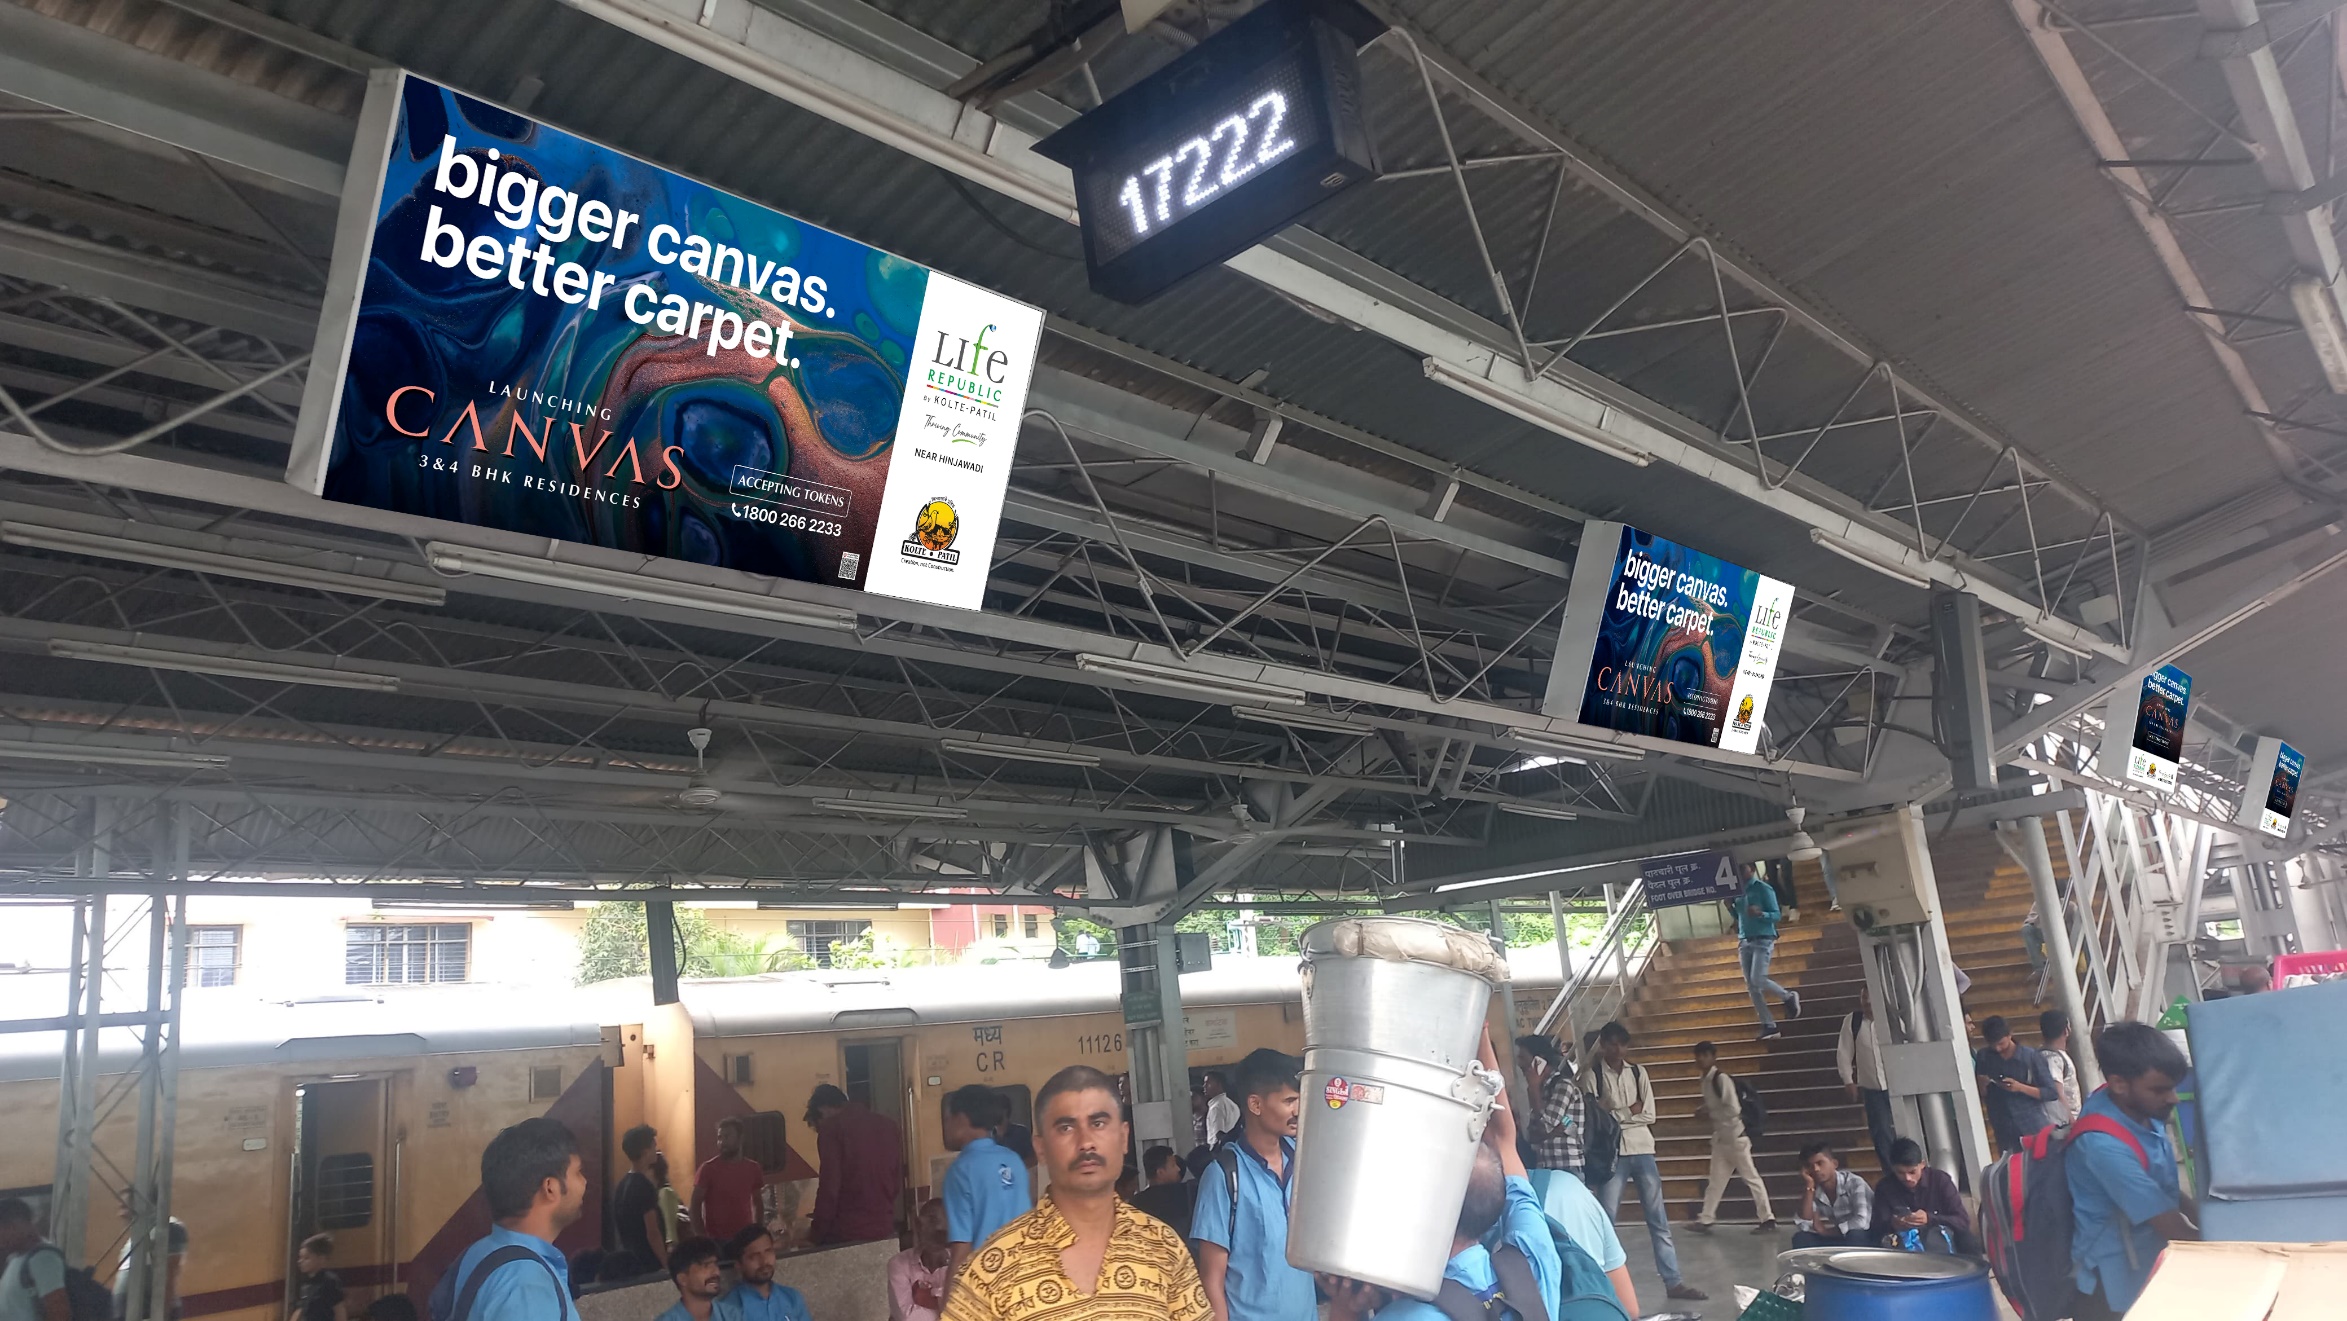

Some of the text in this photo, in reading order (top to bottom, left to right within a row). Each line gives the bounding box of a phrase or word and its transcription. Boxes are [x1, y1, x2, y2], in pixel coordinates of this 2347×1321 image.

[1120, 91, 1294, 234] 17222
[434, 133, 836, 319] bigger canvas.
[420, 204, 801, 369] better carpet.
[488, 380, 612, 422] LAUNCHING
[928, 368, 1002, 402] REPUBLIC
[934, 395, 996, 422] KOLTE-PATIL
[386, 385, 685, 490] CANVAS
[914, 447, 984, 473] NEAR HINJAWADI
[472, 464, 513, 484] BHK
[523, 475, 641, 509] RESIDENCES
[737, 475, 845, 508] ACCEPTING TOKENS
[743, 505, 842, 537] 1800 266 2233
[904, 544, 957, 562] KOLTE PATIL
[1624, 548, 1728, 608] bigger canvas.
[1616, 582, 1714, 636] better carpet.
[1597, 666, 1674, 704] CANVAS
[1715, 856, 1738, 891] 4
[1650, 885, 1717, 903] FOOT OVER BRIDGE NO.
[972, 1025, 1003, 1046] मध्य
[1077, 1033, 1122, 1055] 11126
